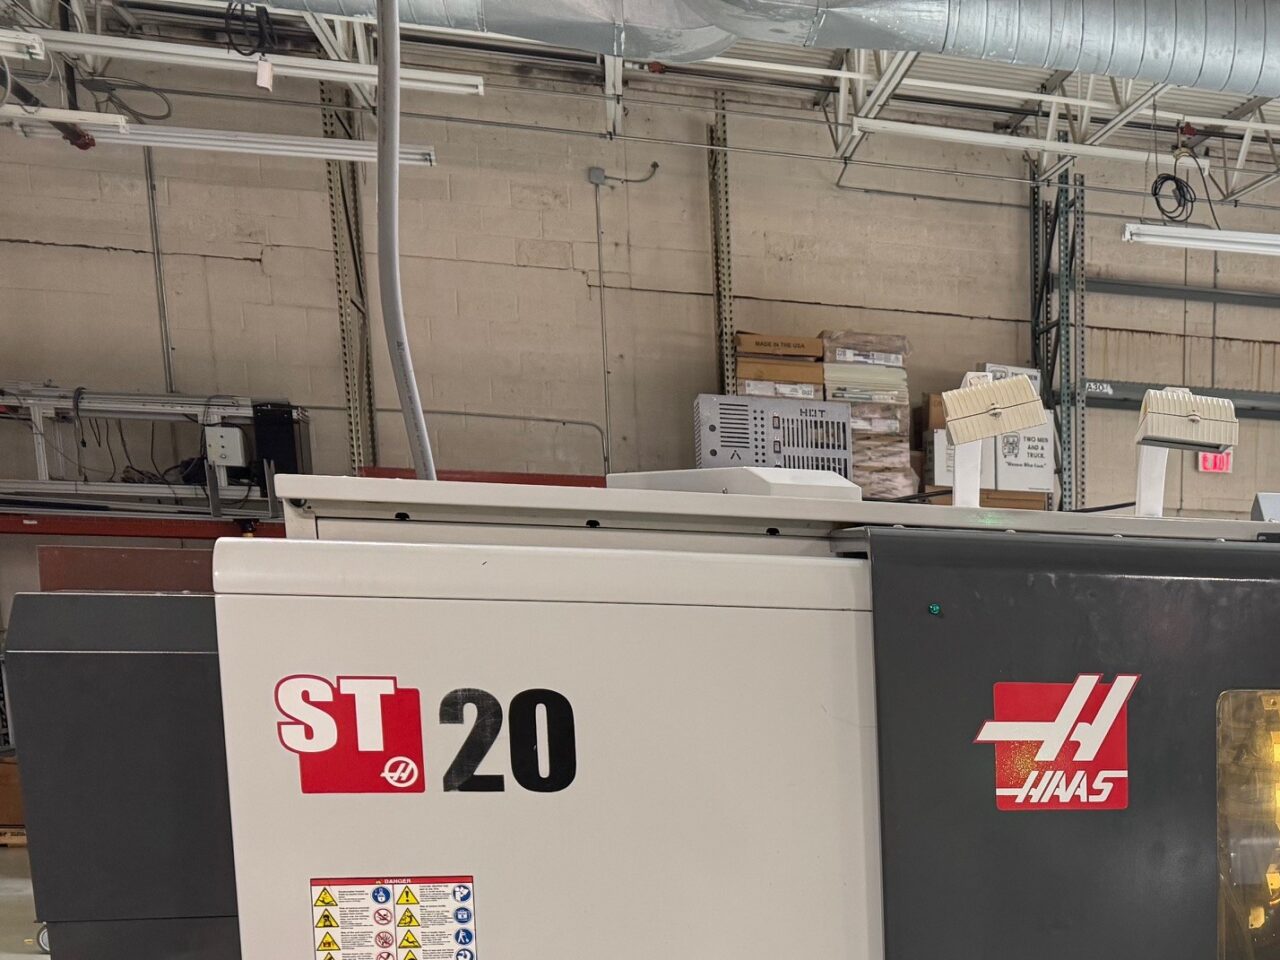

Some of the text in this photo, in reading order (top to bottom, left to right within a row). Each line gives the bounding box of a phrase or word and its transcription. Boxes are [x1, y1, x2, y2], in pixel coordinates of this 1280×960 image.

[1202, 452, 1231, 470] EXIT
[276, 675, 576, 793] ST 20
[996, 770, 1128, 803] HAAS
